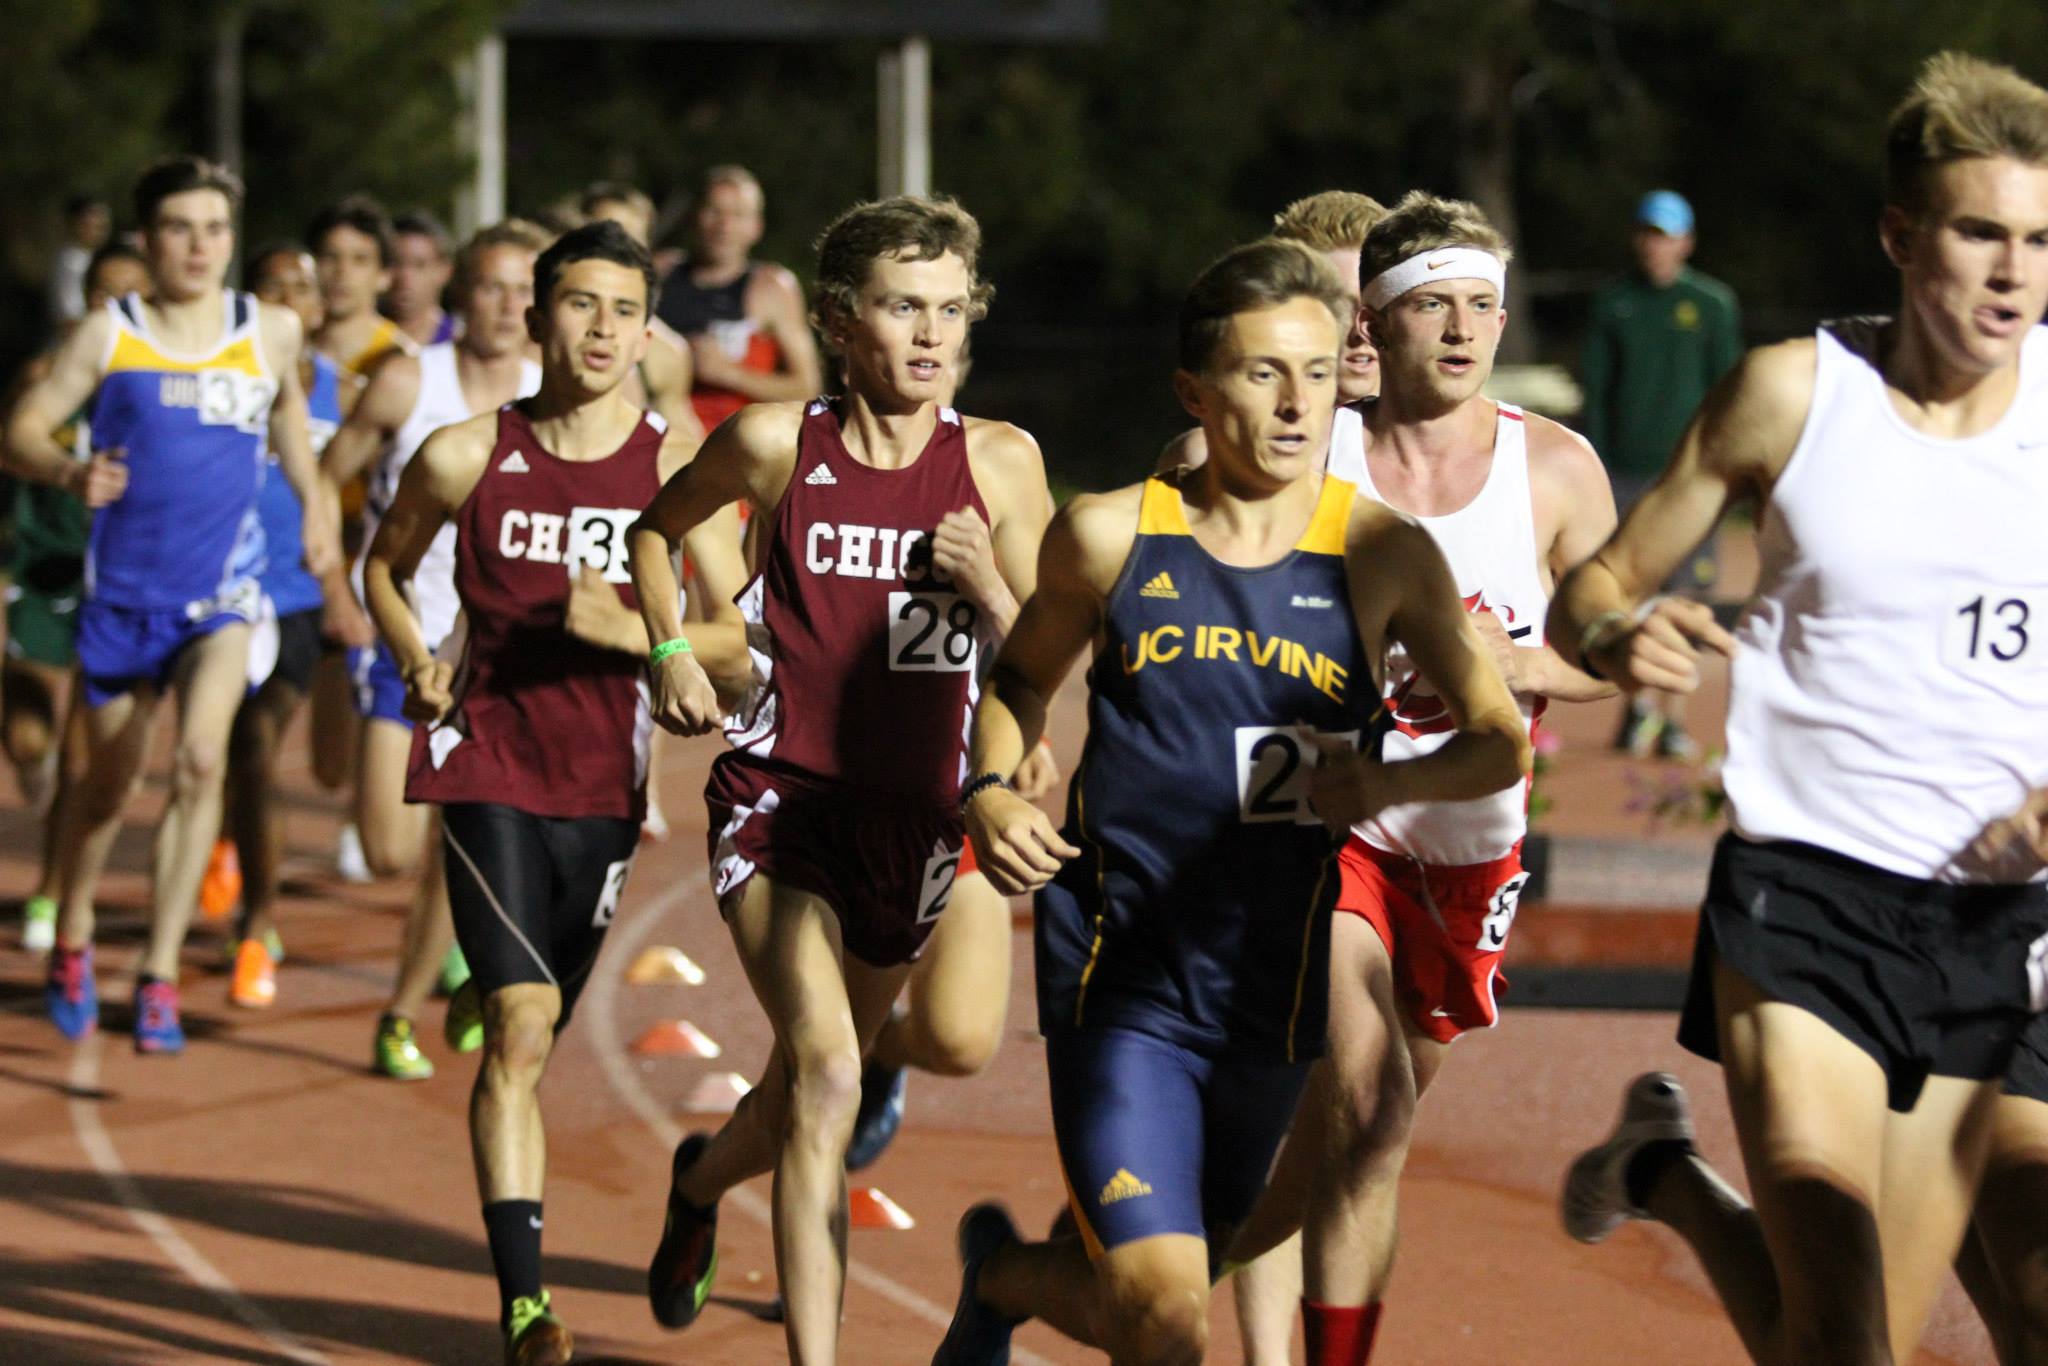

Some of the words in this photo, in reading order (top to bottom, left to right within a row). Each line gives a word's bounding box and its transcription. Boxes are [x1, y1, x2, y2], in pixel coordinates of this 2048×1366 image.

[897, 598, 977, 665] 28
[1958, 594, 2029, 661] 13
[1121, 624, 1185, 677] UC
[1193, 625, 1349, 705] IRVINE
